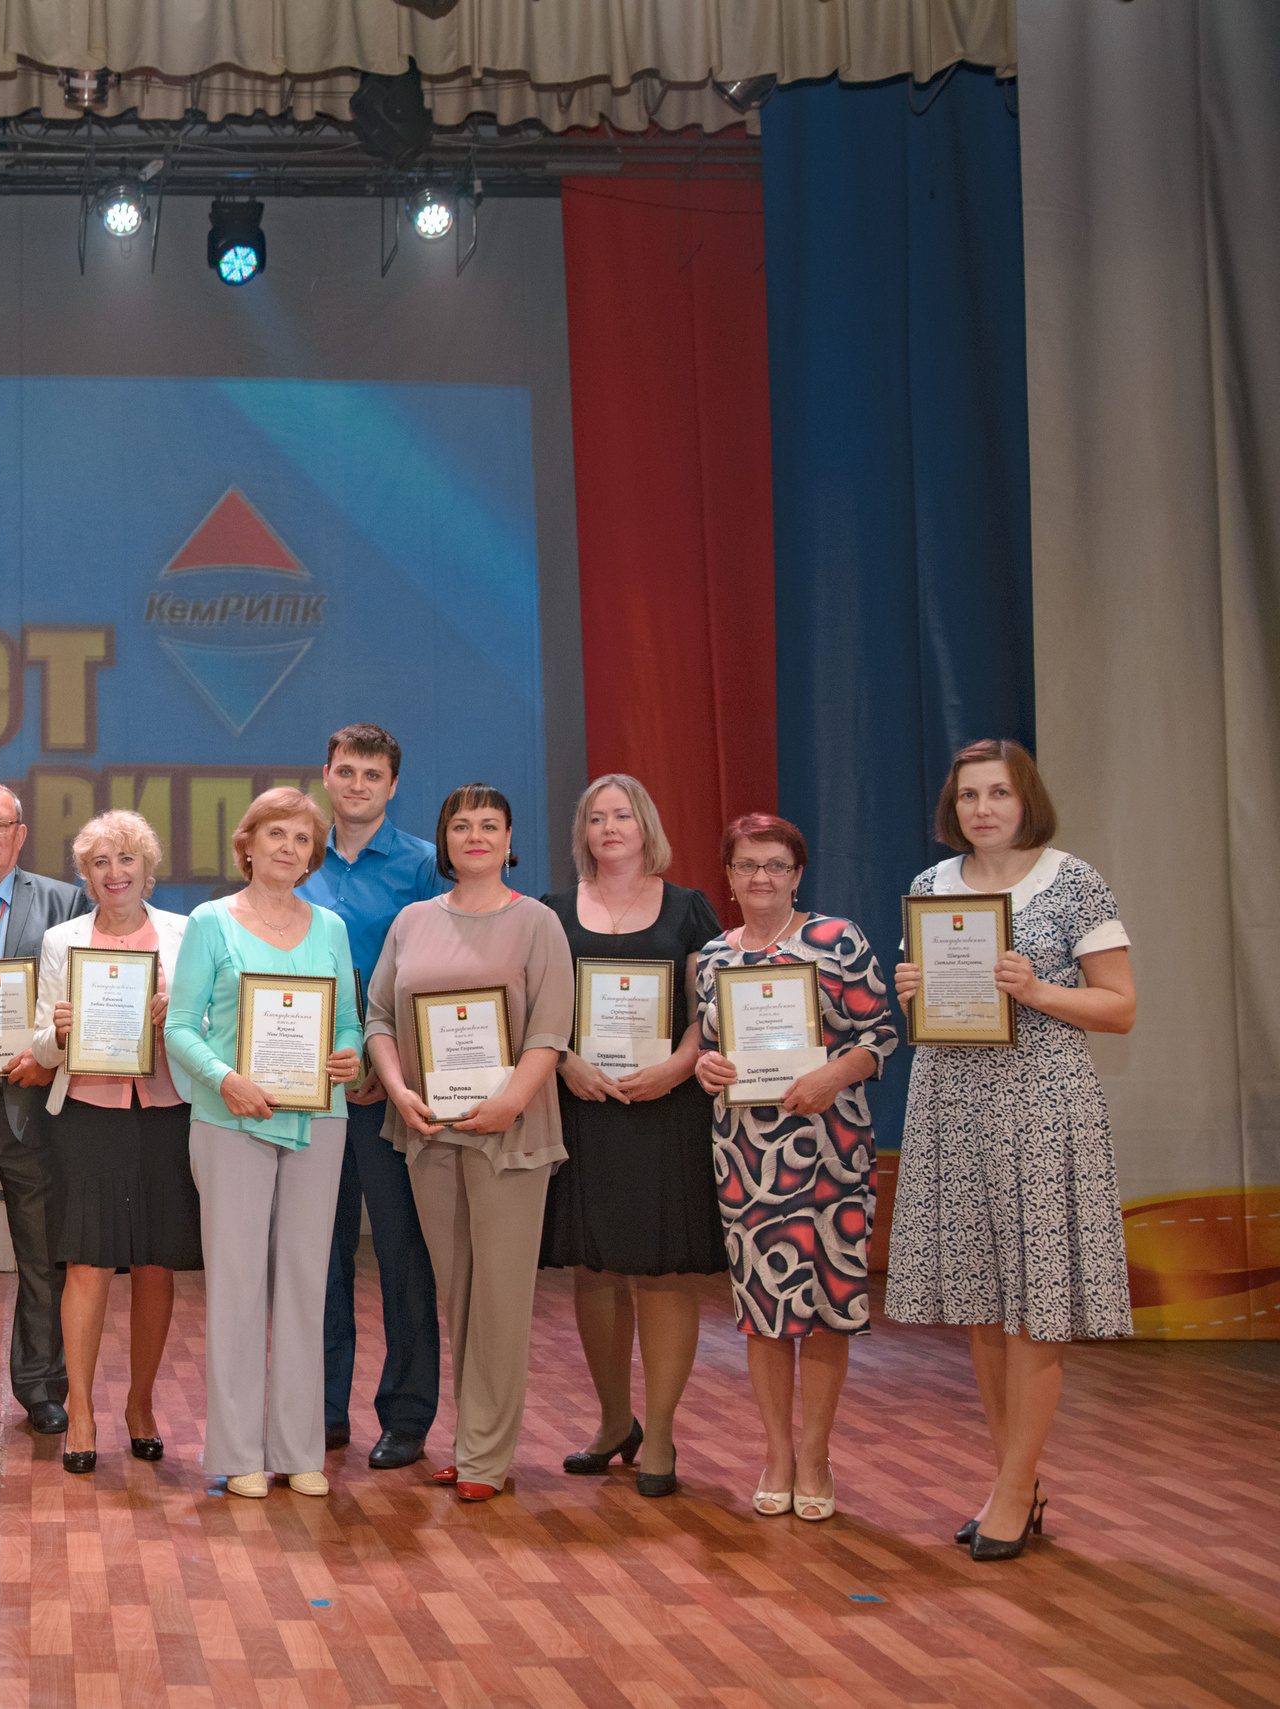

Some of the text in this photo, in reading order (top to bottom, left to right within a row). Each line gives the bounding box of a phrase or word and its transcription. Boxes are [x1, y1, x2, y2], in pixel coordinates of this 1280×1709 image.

[144, 592, 326, 624] КемРИПК
[747, 1067, 779, 1075] Сыстерова
[758, 1075, 794, 1083] Германовна
